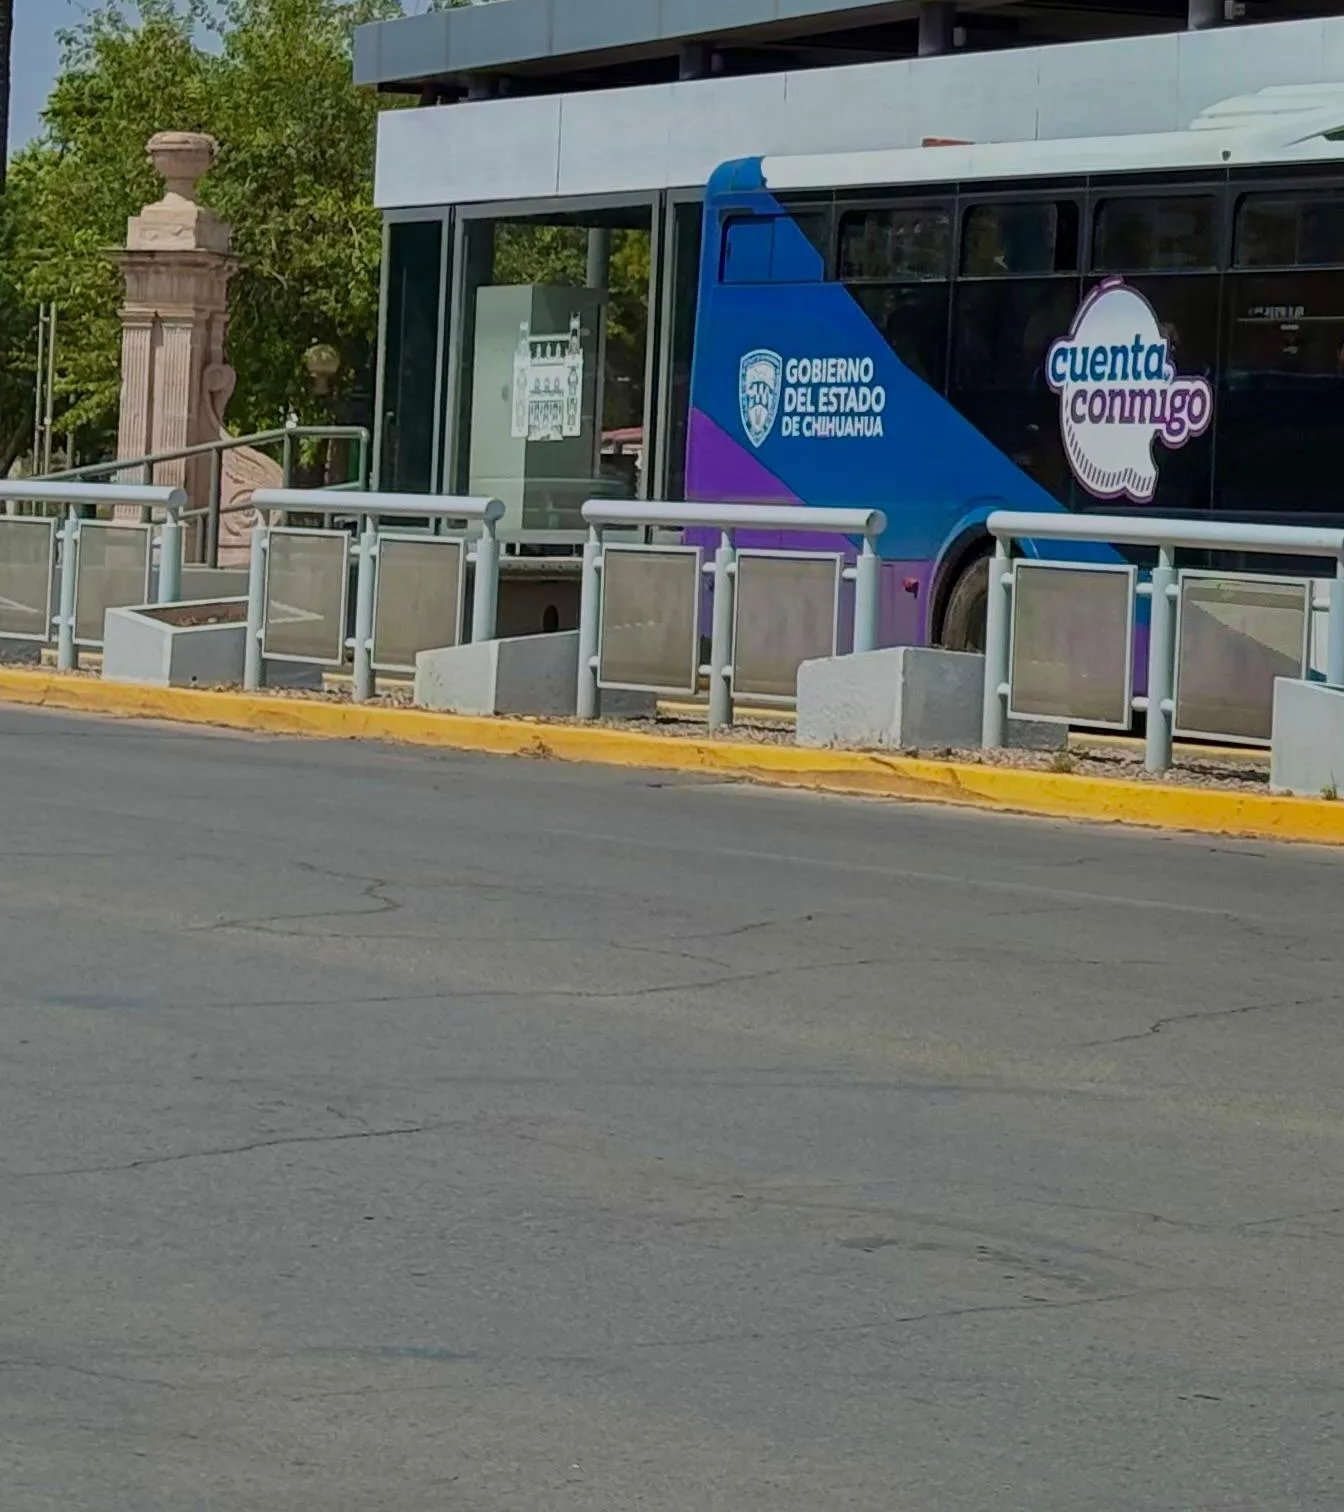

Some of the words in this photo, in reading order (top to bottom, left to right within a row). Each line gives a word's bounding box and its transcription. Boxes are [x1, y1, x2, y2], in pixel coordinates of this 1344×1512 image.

[786, 357, 874, 384] GOBIERNO
[1051, 333, 1165, 382] cuenta
[784, 387, 816, 413] DEL
[818, 386, 886, 413] ESTADO
[1070, 388, 1208, 437] conmigo
[781, 416, 801, 437] DE
[802, 416, 884, 438] CHIHUAHUA
